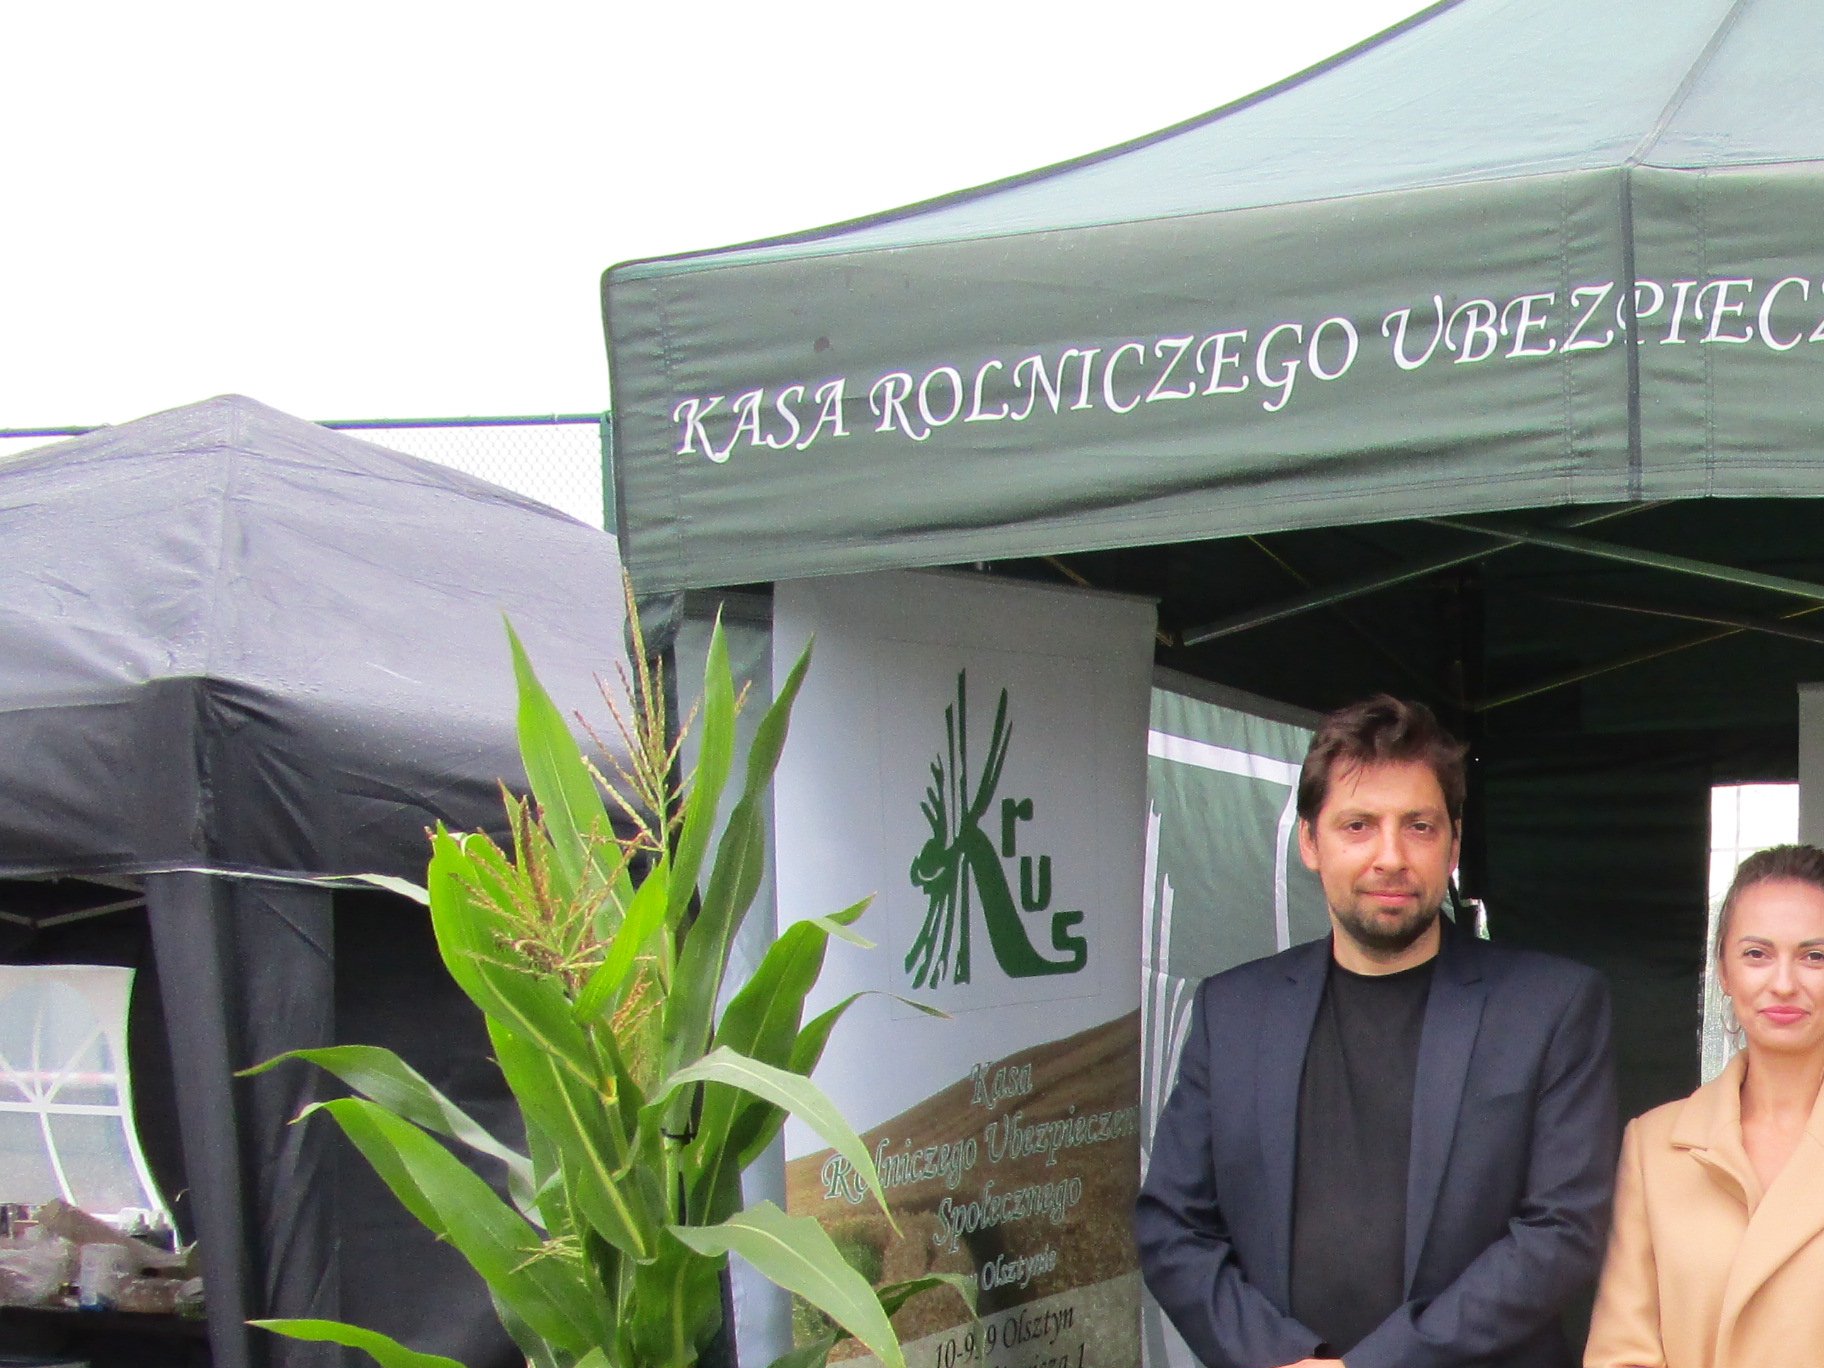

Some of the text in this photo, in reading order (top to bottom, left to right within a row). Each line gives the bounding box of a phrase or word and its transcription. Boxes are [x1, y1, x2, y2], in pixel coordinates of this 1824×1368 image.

[673, 383, 851, 463] KASA
[870, 316, 1358, 441] ROLNICZEGO
[970, 1062, 1033, 1110] Kasa
[984, 1105, 1139, 1167] Ubezpieczen
[932, 1179, 1082, 1254] Społecznego
[1003, 1306, 1074, 1348] Olsztyn
